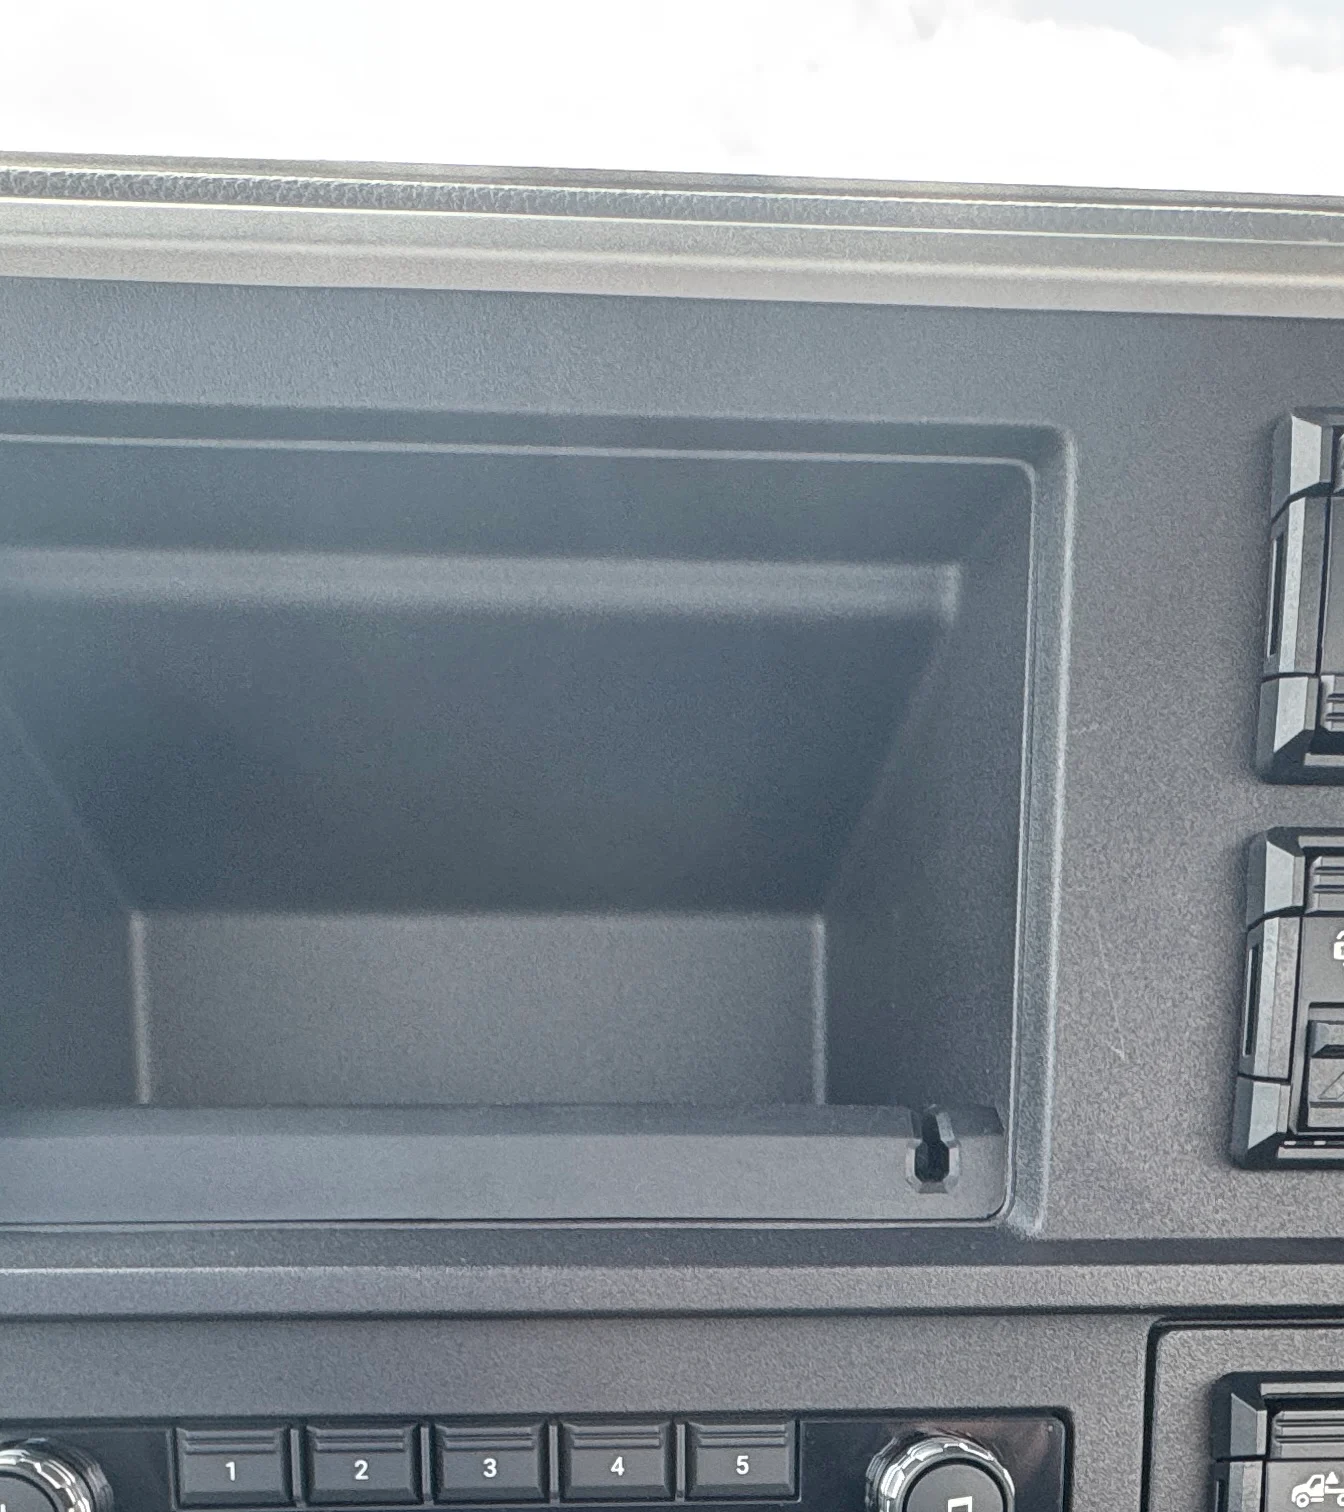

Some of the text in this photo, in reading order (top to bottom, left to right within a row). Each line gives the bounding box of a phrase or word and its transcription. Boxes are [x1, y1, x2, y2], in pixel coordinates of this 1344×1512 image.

[225, 1461, 236, 1481] 1
[354, 1459, 369, 1480] 2
[483, 1457, 497, 1478] 3
[610, 1456, 625, 1476] 4
[735, 1455, 750, 1475] 5
